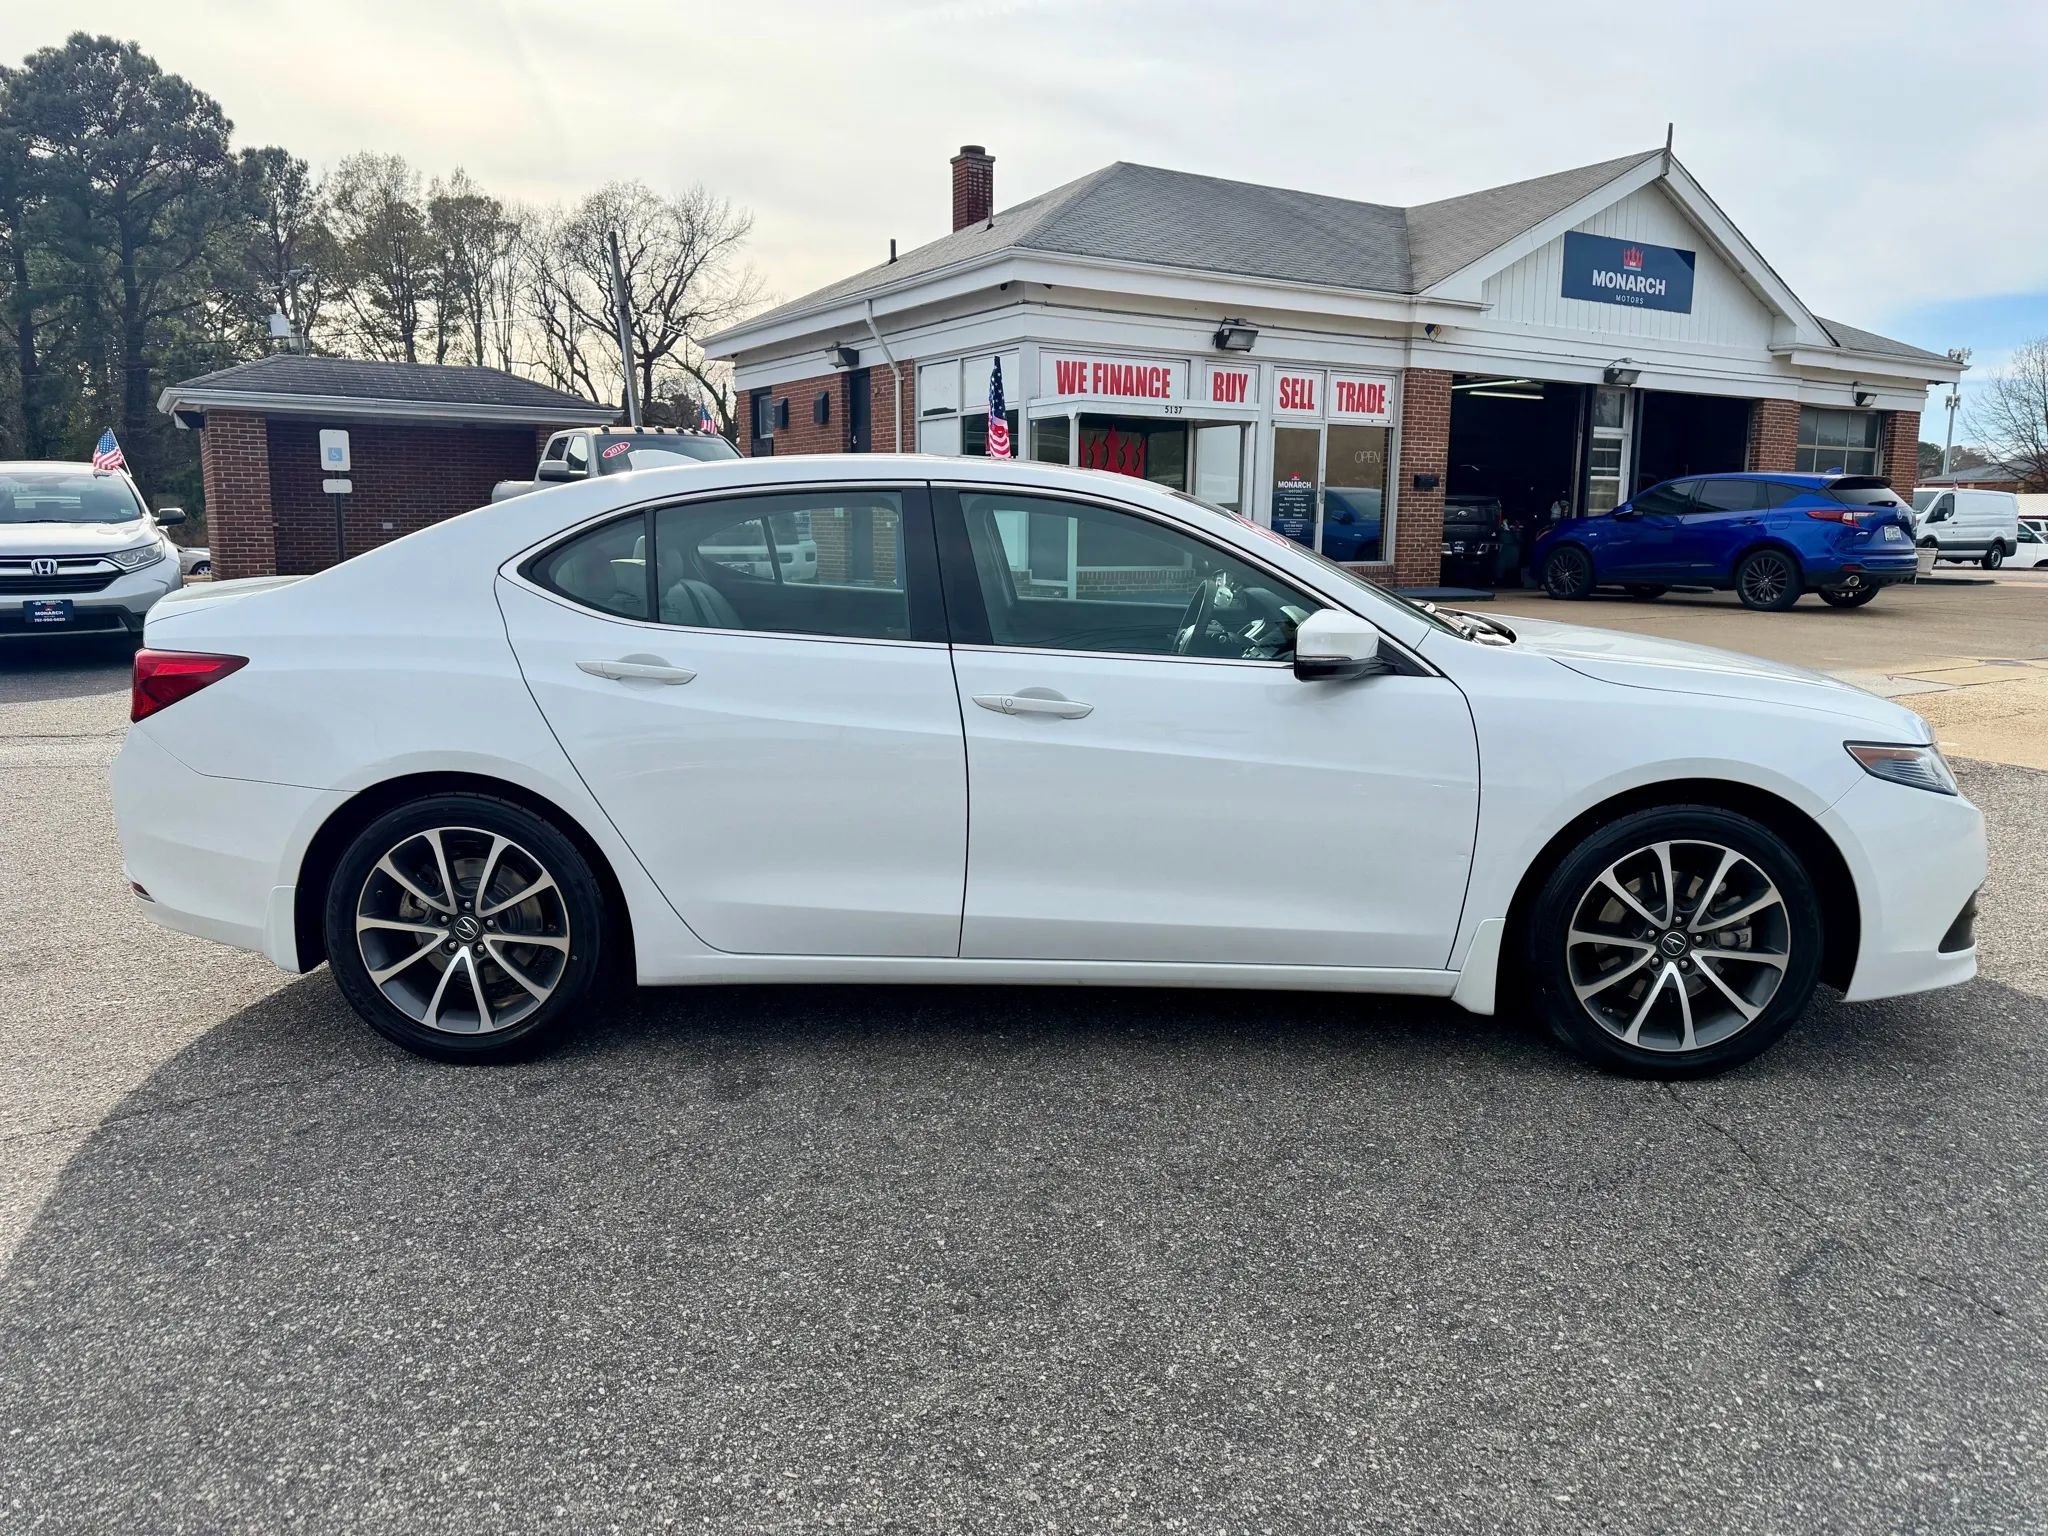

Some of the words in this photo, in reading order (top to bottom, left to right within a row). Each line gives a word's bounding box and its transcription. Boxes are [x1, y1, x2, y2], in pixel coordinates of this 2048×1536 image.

[1592, 269, 1666, 296] MONARCH
[1615, 294, 1644, 305] MOTORS
[1056, 360, 1087, 395] WE
[1092, 362, 1171, 398] FINANCE
[1213, 371, 1249, 403] BUY
[1280, 376, 1315, 410] SELL
[1336, 381, 1386, 414] TRADE
[1164, 405, 1183, 415] 5137
[1354, 450, 1381, 464] OPEN
[1277, 480, 1312, 489] MONARCH
